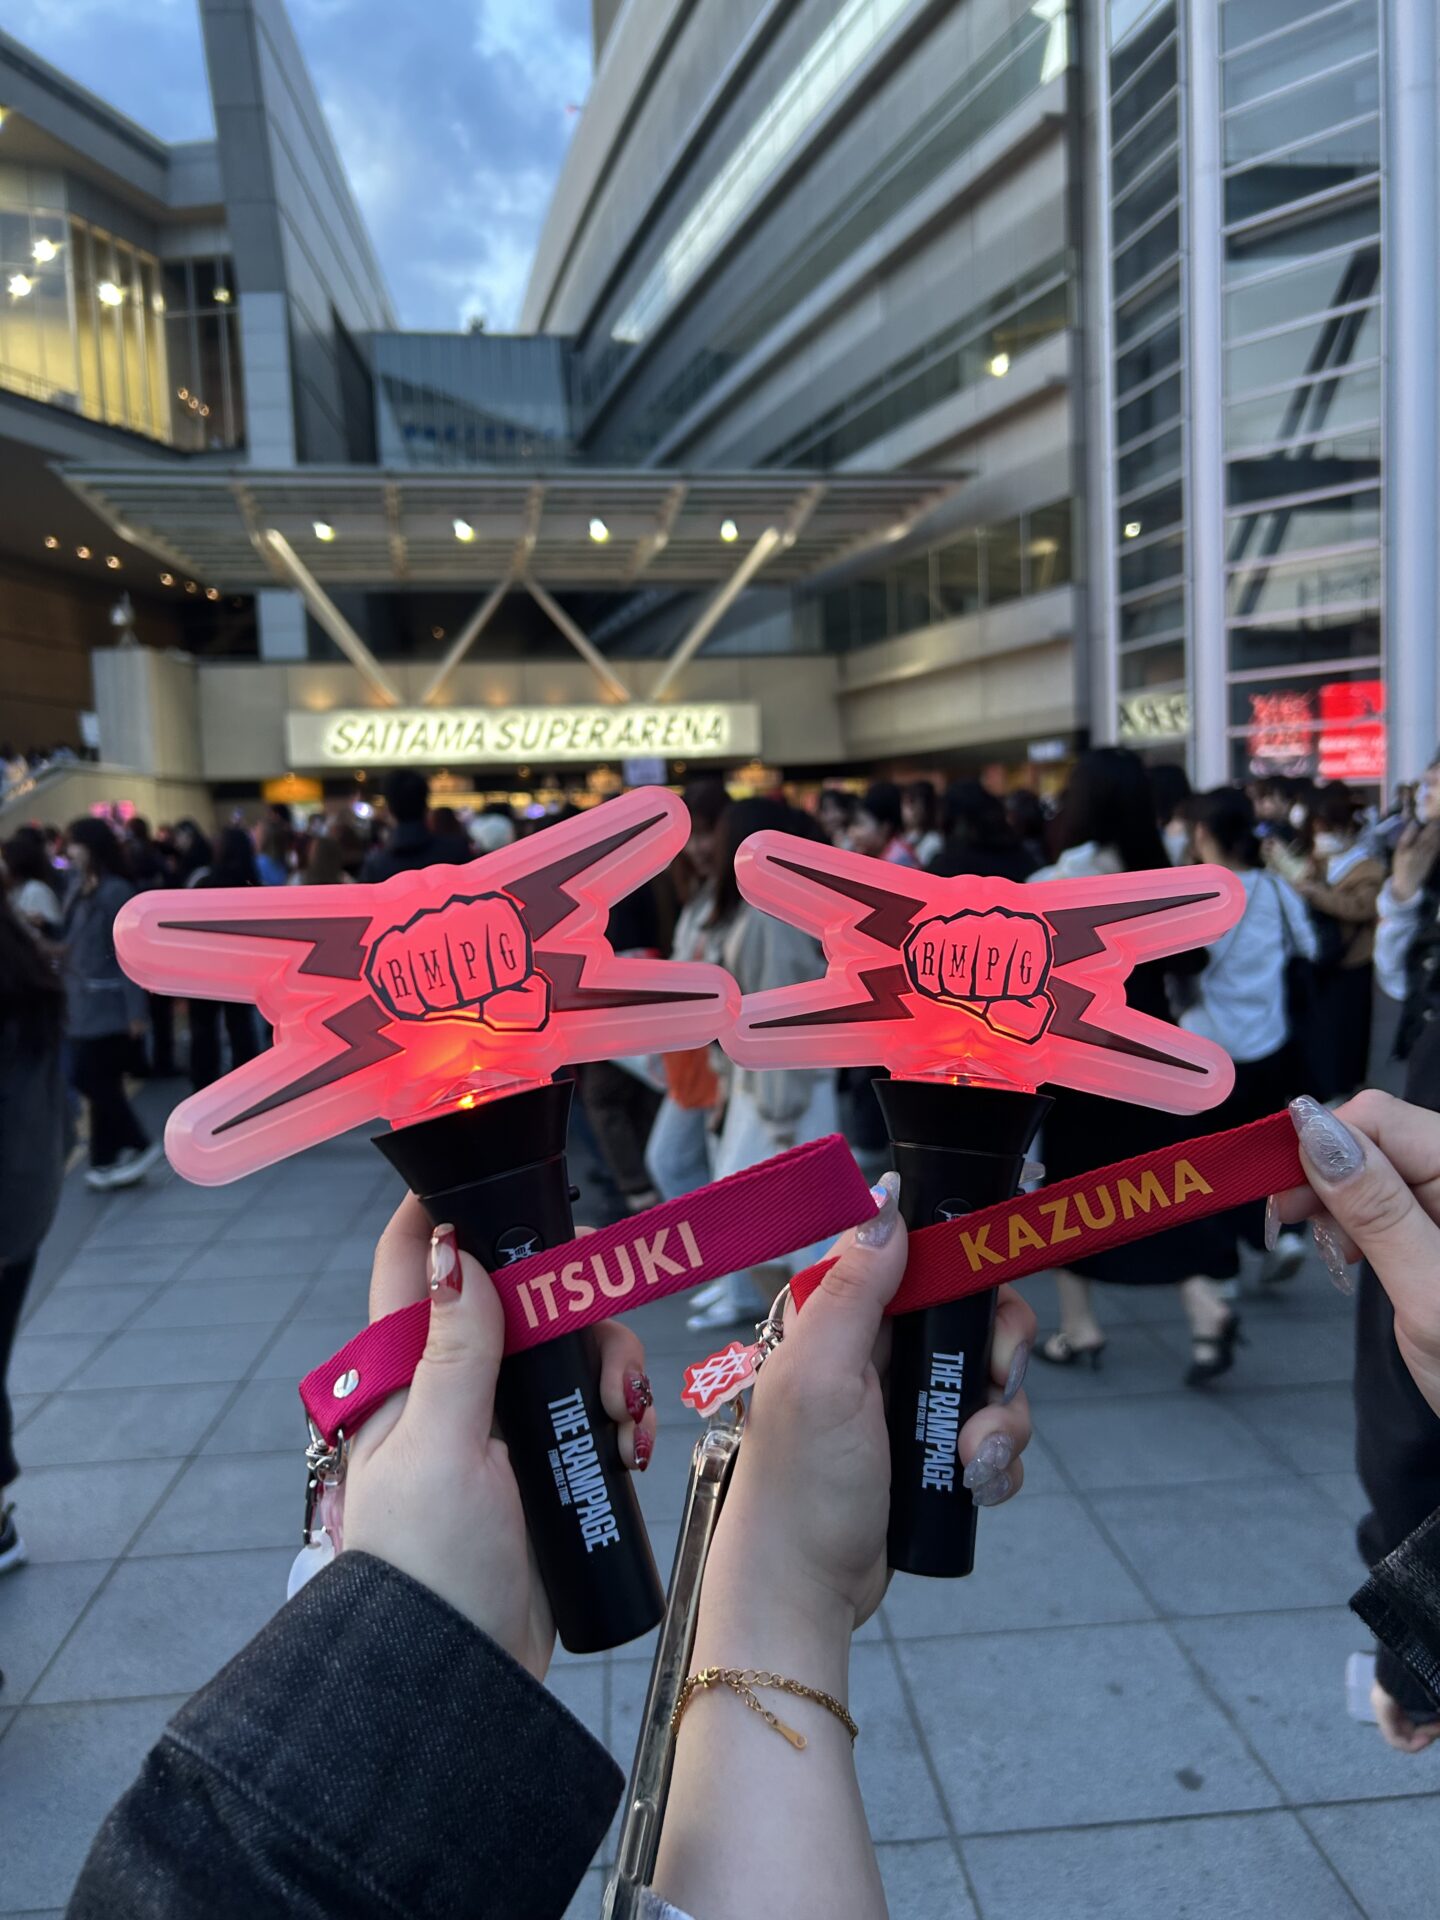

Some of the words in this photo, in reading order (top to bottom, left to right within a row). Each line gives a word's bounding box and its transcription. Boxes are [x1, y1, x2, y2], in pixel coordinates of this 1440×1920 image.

[332, 718, 485, 754] SAITAMA
[495, 715, 610, 751] SUPER
[614, 714, 722, 747] ARENA
[386, 932, 518, 999] RMPG
[920, 941, 1032, 985] RMPG
[959, 1158, 1214, 1272] KAZUMA
[516, 1220, 704, 1328] ITSUKI
[931, 1352, 964, 1389] THE
[548, 1387, 590, 1441] THE
[922, 1390, 960, 1491] RAMPAGE
[559, 1432, 621, 1553] RAMPAGE
